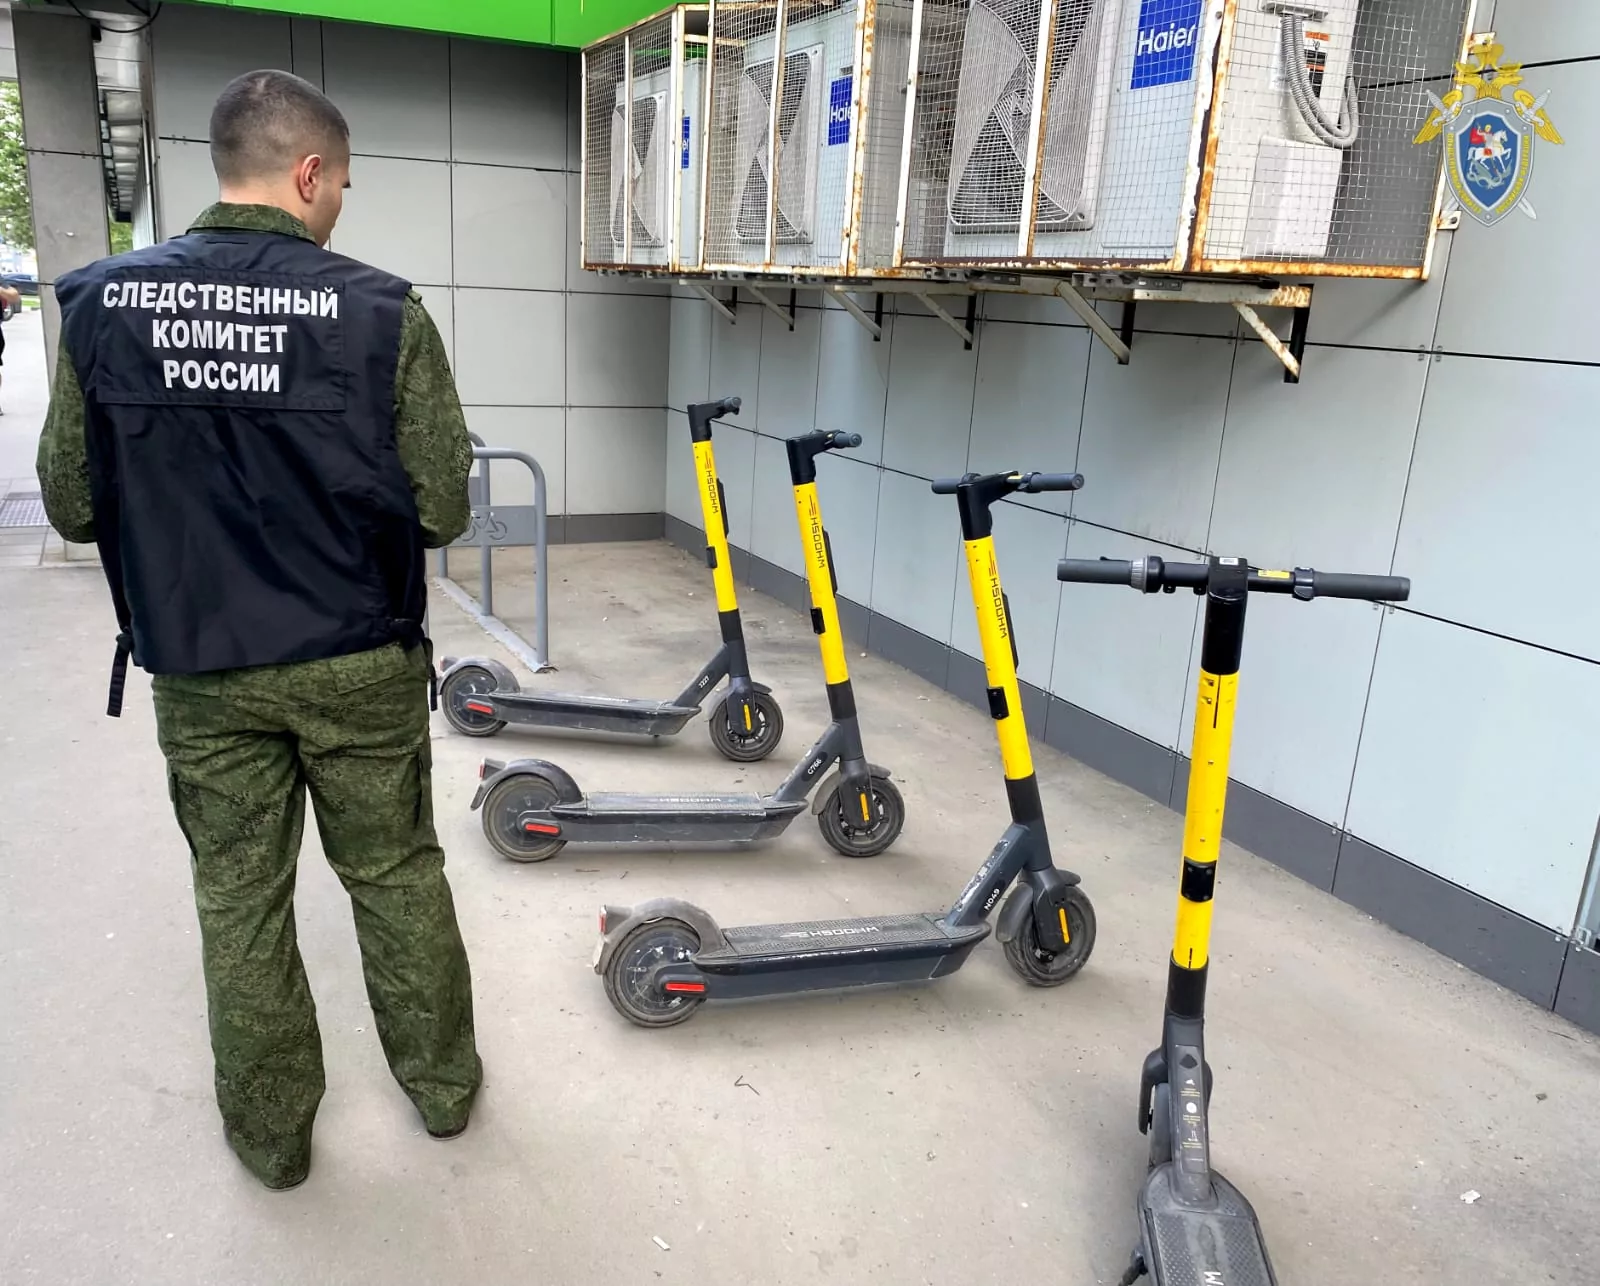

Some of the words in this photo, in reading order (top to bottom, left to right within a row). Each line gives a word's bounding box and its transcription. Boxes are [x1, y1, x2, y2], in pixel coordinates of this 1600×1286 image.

[1137, 21, 1196, 56] Haier
[830, 102, 852, 123] Haie
[103, 281, 338, 319] СЛЕДСТВЕННЫЙ
[152, 319, 288, 353] КОМИТЕТ
[163, 359, 280, 393] РОССИИ
[705, 470, 719, 514] WHOOSH
[810, 517, 825, 569] WHOOSH
[989, 577, 1008, 640] WHOOSH
[809, 925, 880, 939] WHOOSH
